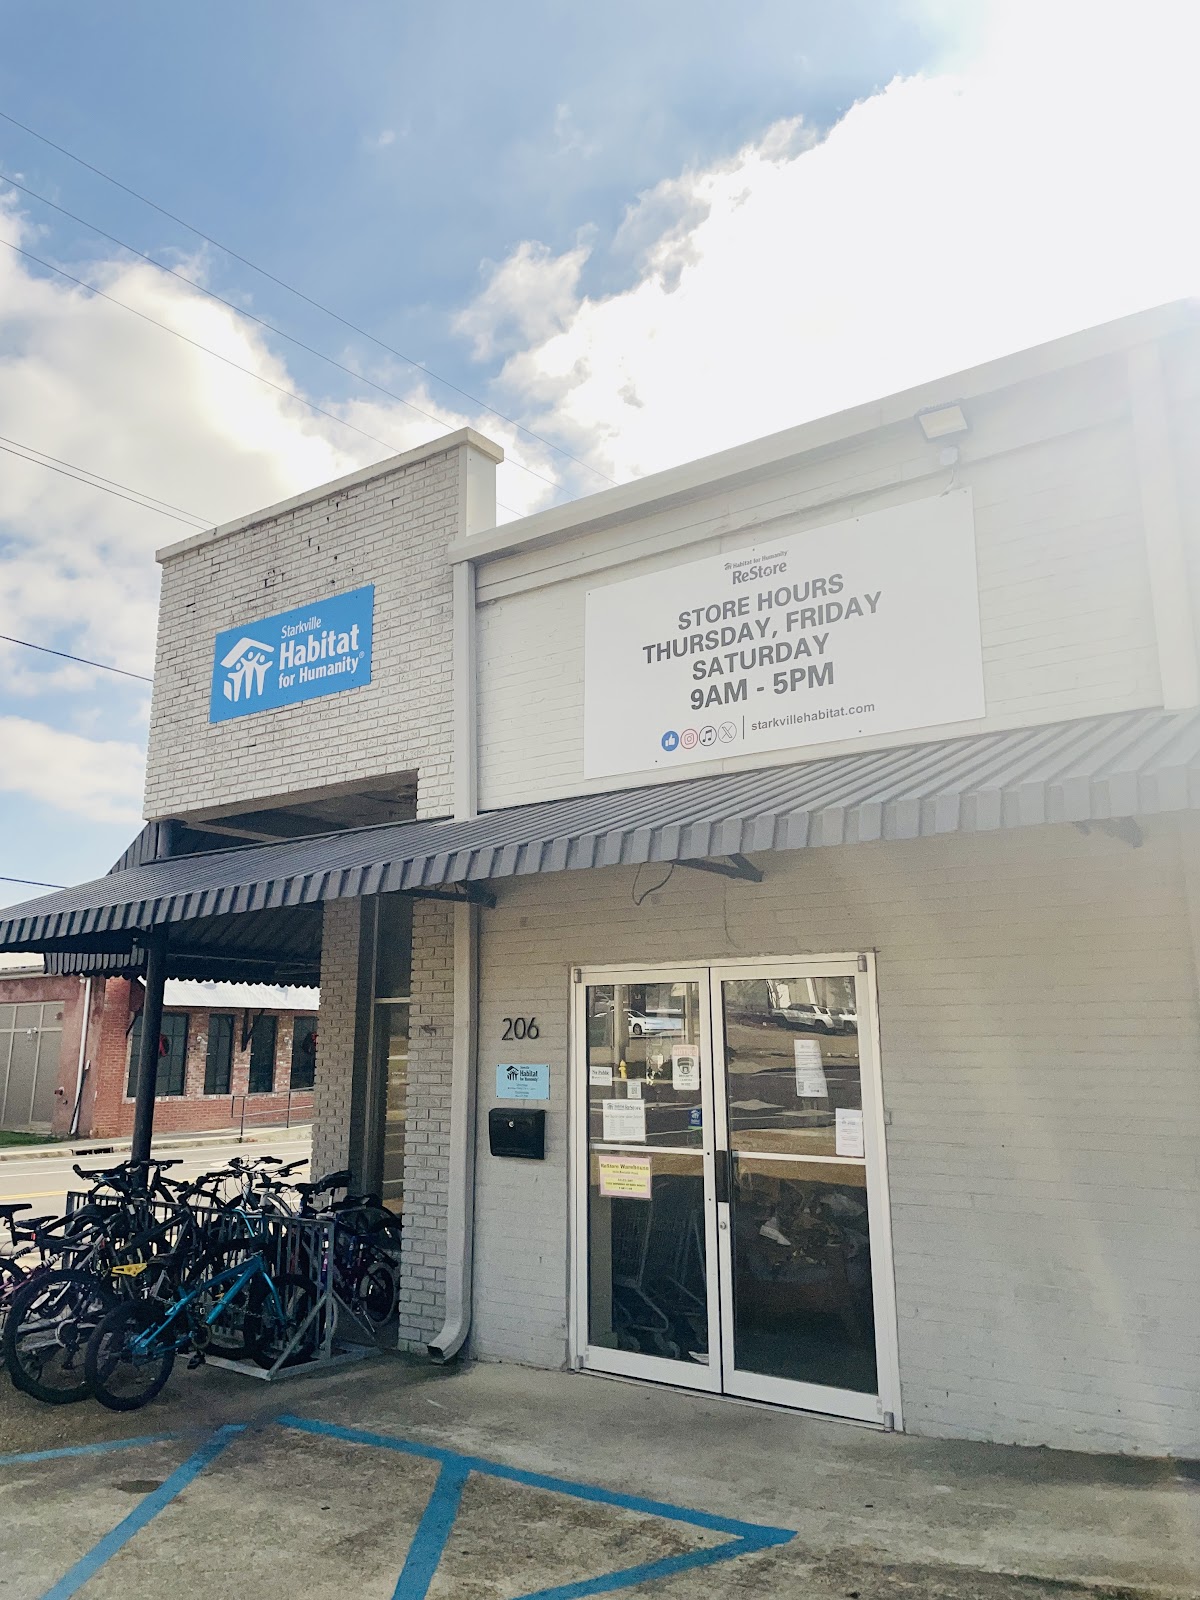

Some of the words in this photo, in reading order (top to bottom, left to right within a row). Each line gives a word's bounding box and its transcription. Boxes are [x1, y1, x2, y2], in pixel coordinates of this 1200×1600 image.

[732, 562, 787, 585] ReStore
[678, 596, 750, 630] STORE
[757, 573, 844, 611] HOURS
[279, 623, 360, 670] Habitat
[281, 616, 322, 639] Starkville
[642, 617, 778, 664] THURSDAY,
[786, 591, 882, 633] FRIDAY
[278, 672, 295, 689] for
[299, 655, 359, 684] Humanity
[692, 632, 830, 681] SATURDAY
[690, 678, 748, 710] 9AM
[773, 661, 835, 695] 5PM
[751, 703, 875, 731] starkvillehabitat.com
[501, 1016, 540, 1041] 206
